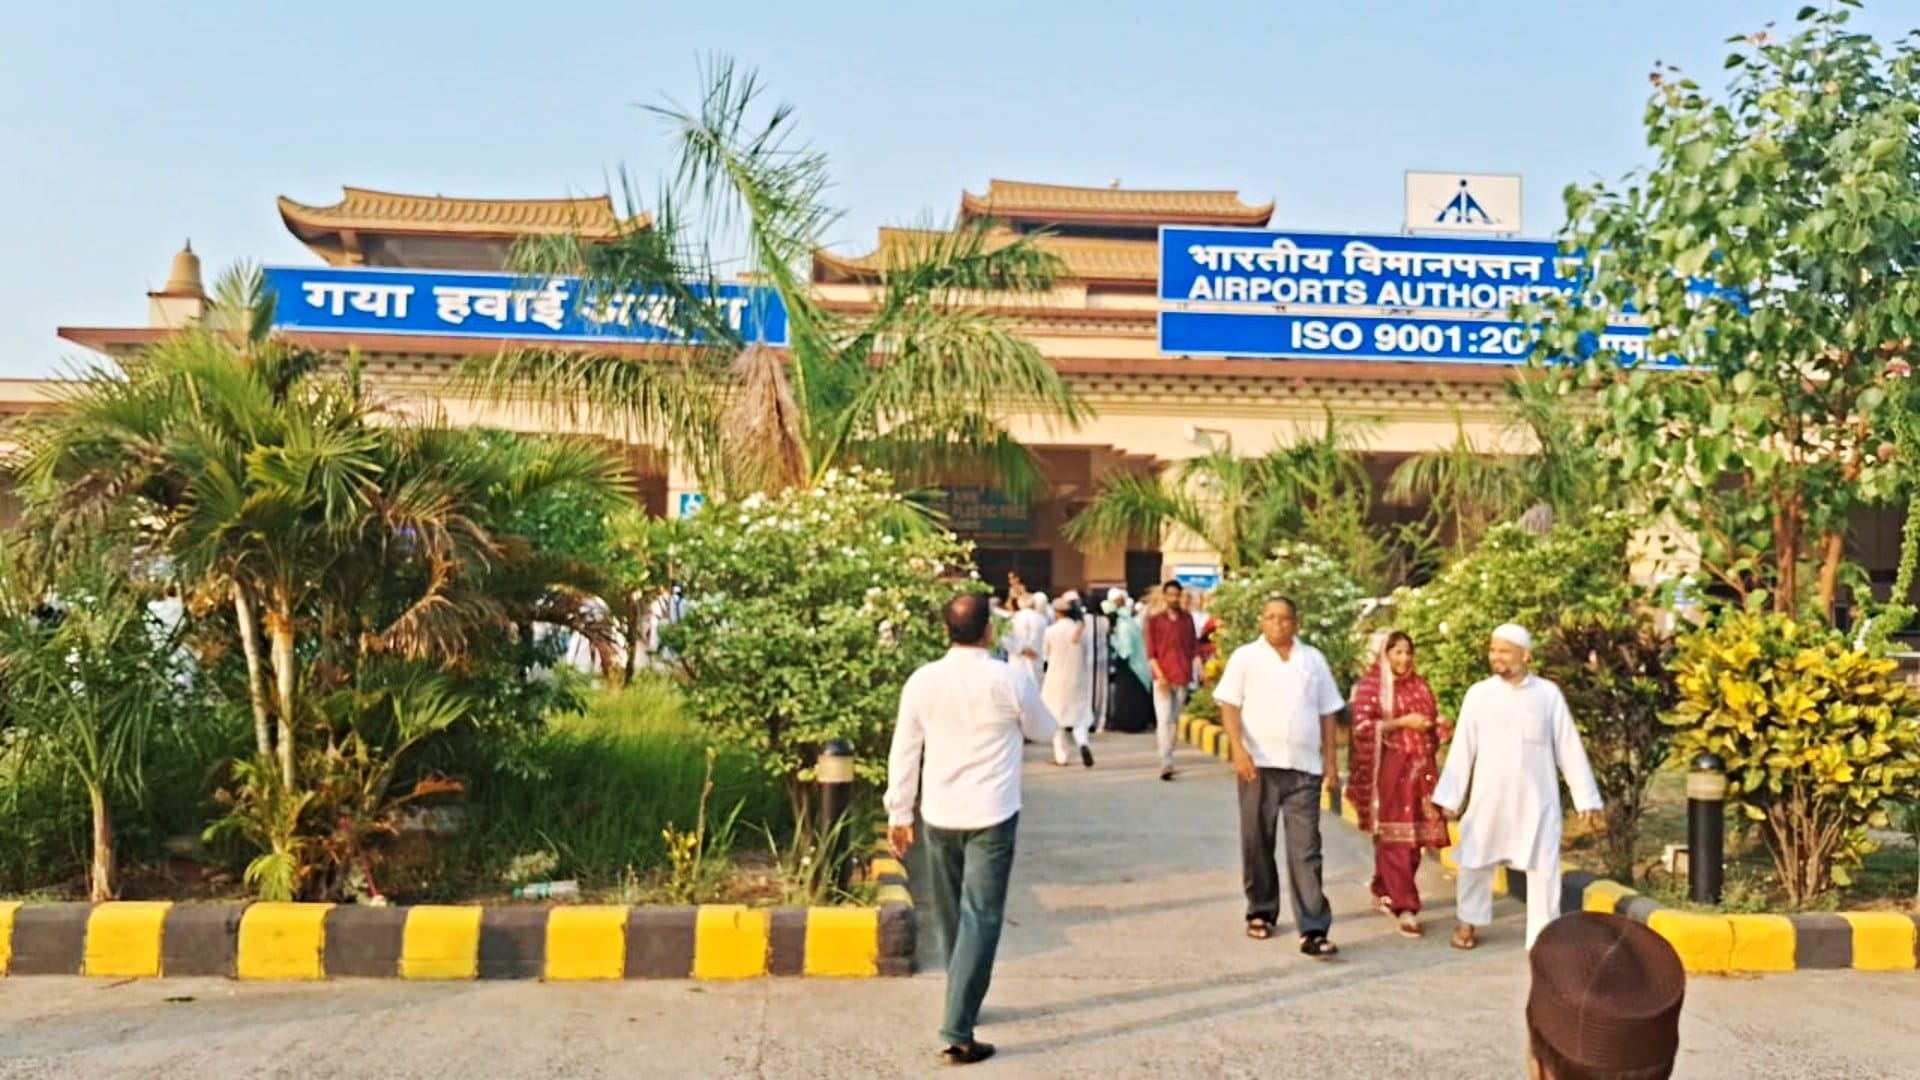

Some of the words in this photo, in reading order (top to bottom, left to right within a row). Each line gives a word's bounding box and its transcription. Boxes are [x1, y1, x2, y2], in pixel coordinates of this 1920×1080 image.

[1188, 237, 1332, 274] भारतीय
[1341, 240, 1544, 281] विमानपत्तन
[302, 282, 414, 317] गया
[432, 280, 569, 330] हवाई
[1188, 275, 1368, 304] AIRPORTS
[1291, 320, 1363, 350] ISO
